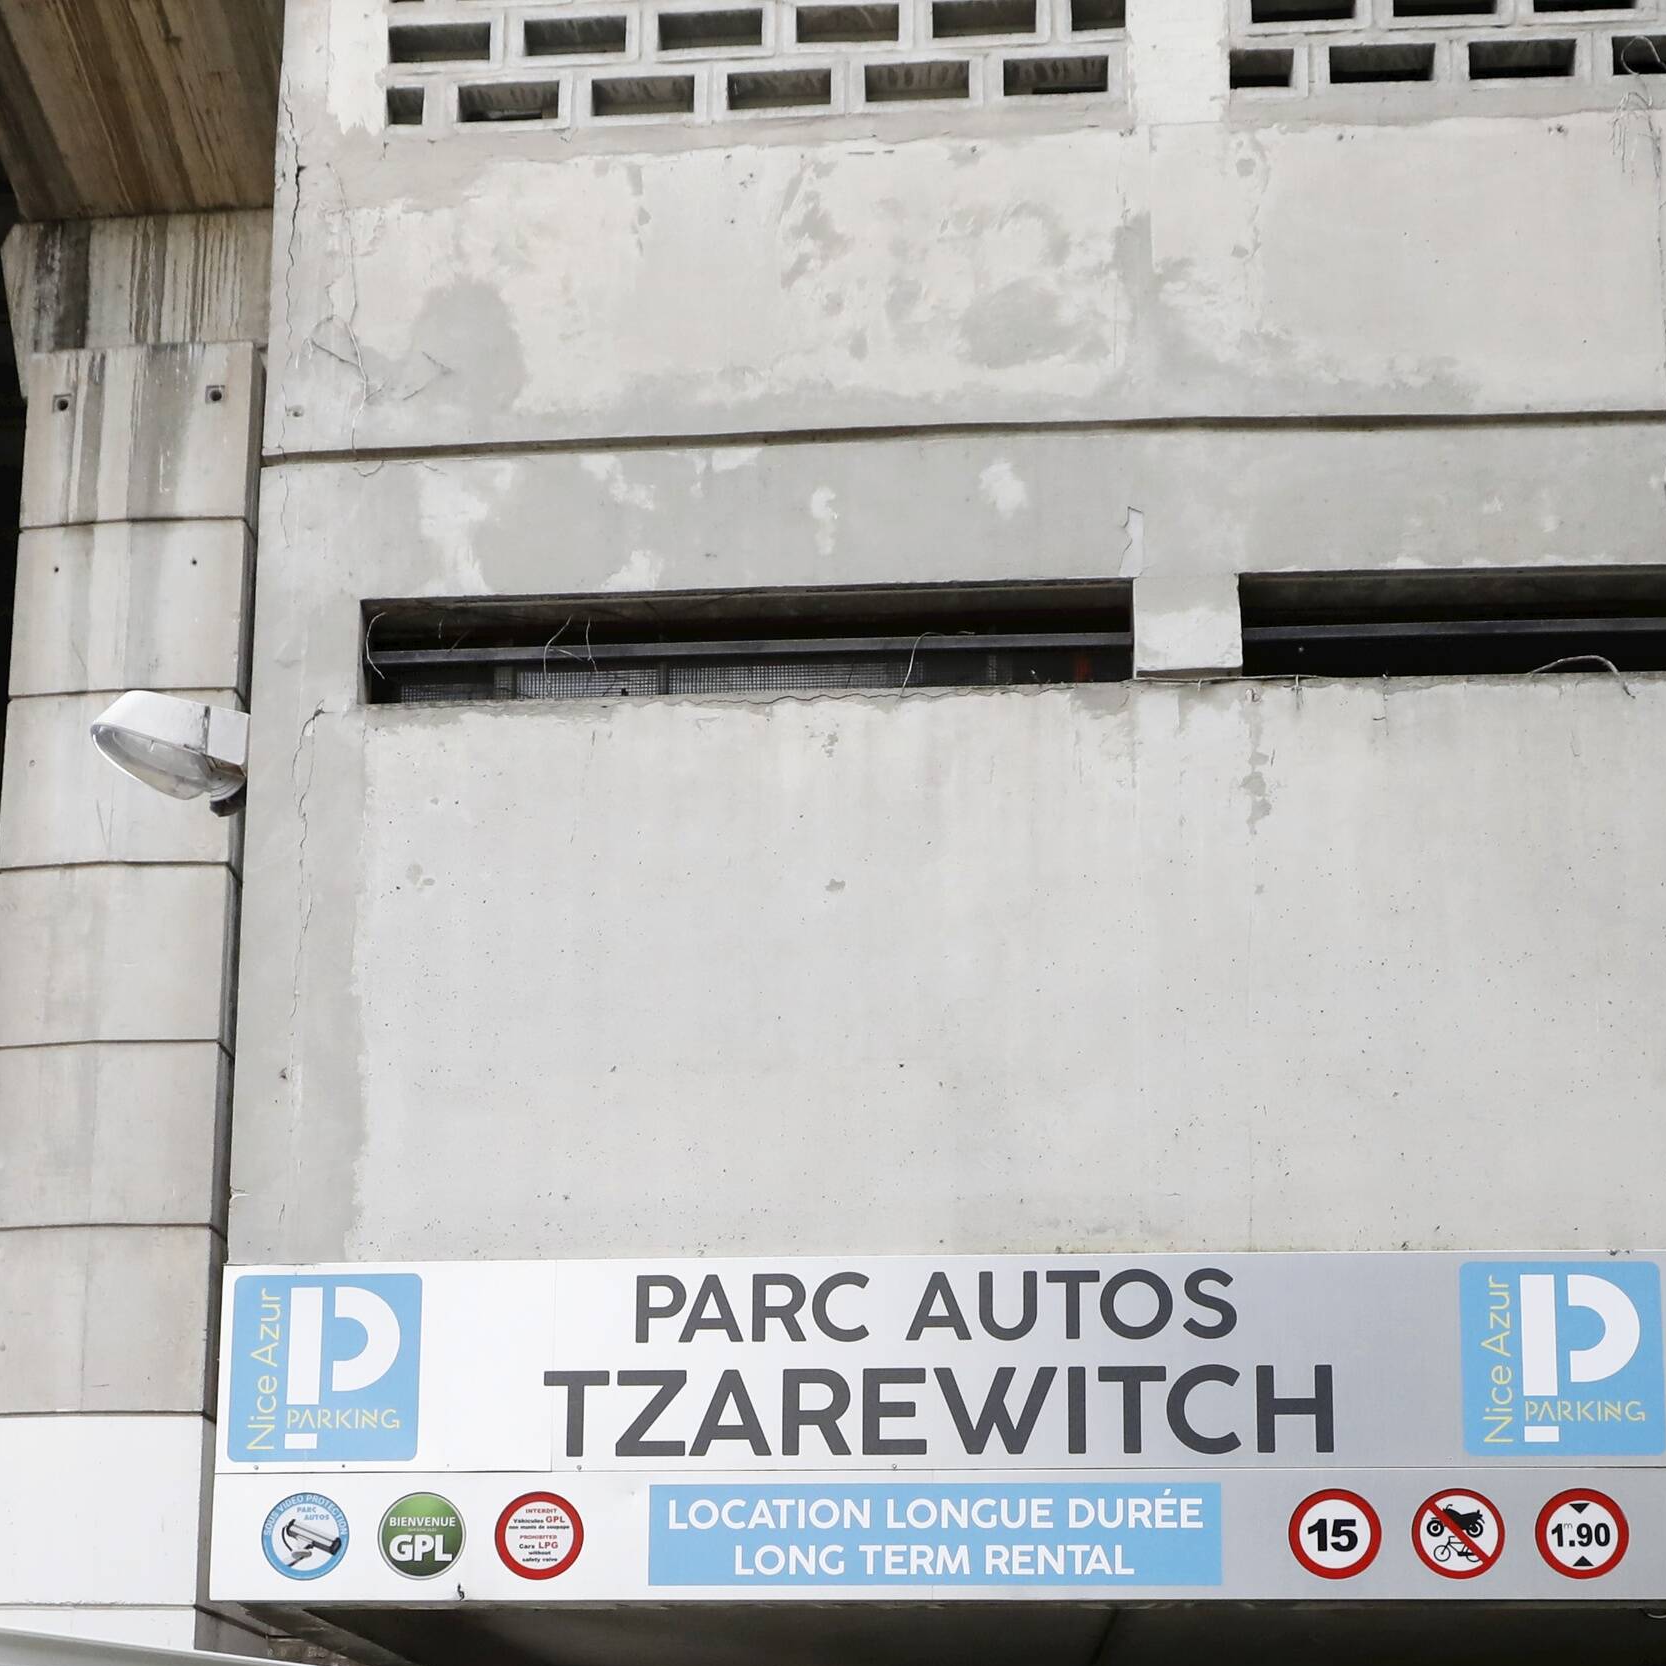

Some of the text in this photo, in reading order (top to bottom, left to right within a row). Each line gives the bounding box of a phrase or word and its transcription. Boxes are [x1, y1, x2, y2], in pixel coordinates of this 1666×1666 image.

[635, 1267, 1238, 1344] PARC AUTOS
[246, 1288, 282, 1450] Nice Azur
[1480, 1274, 1514, 1443] Nice Azur
[287, 1408, 401, 1429] PARKING
[543, 1364, 1334, 1458] TZAREWITCH
[1525, 1401, 1646, 1422] PARKING
[389, 1516, 456, 1527] BIENVENUE
[545, 1515, 566, 1523] GPL
[668, 1488, 1204, 1530] LOCATION LONGUE DURÉE
[389, 1534, 453, 1562] GPL
[538, 1541, 559, 1549] LPG
[1306, 1517, 1359, 1553] 15
[735, 1544, 1135, 1576] LONG TERM RENTAL
